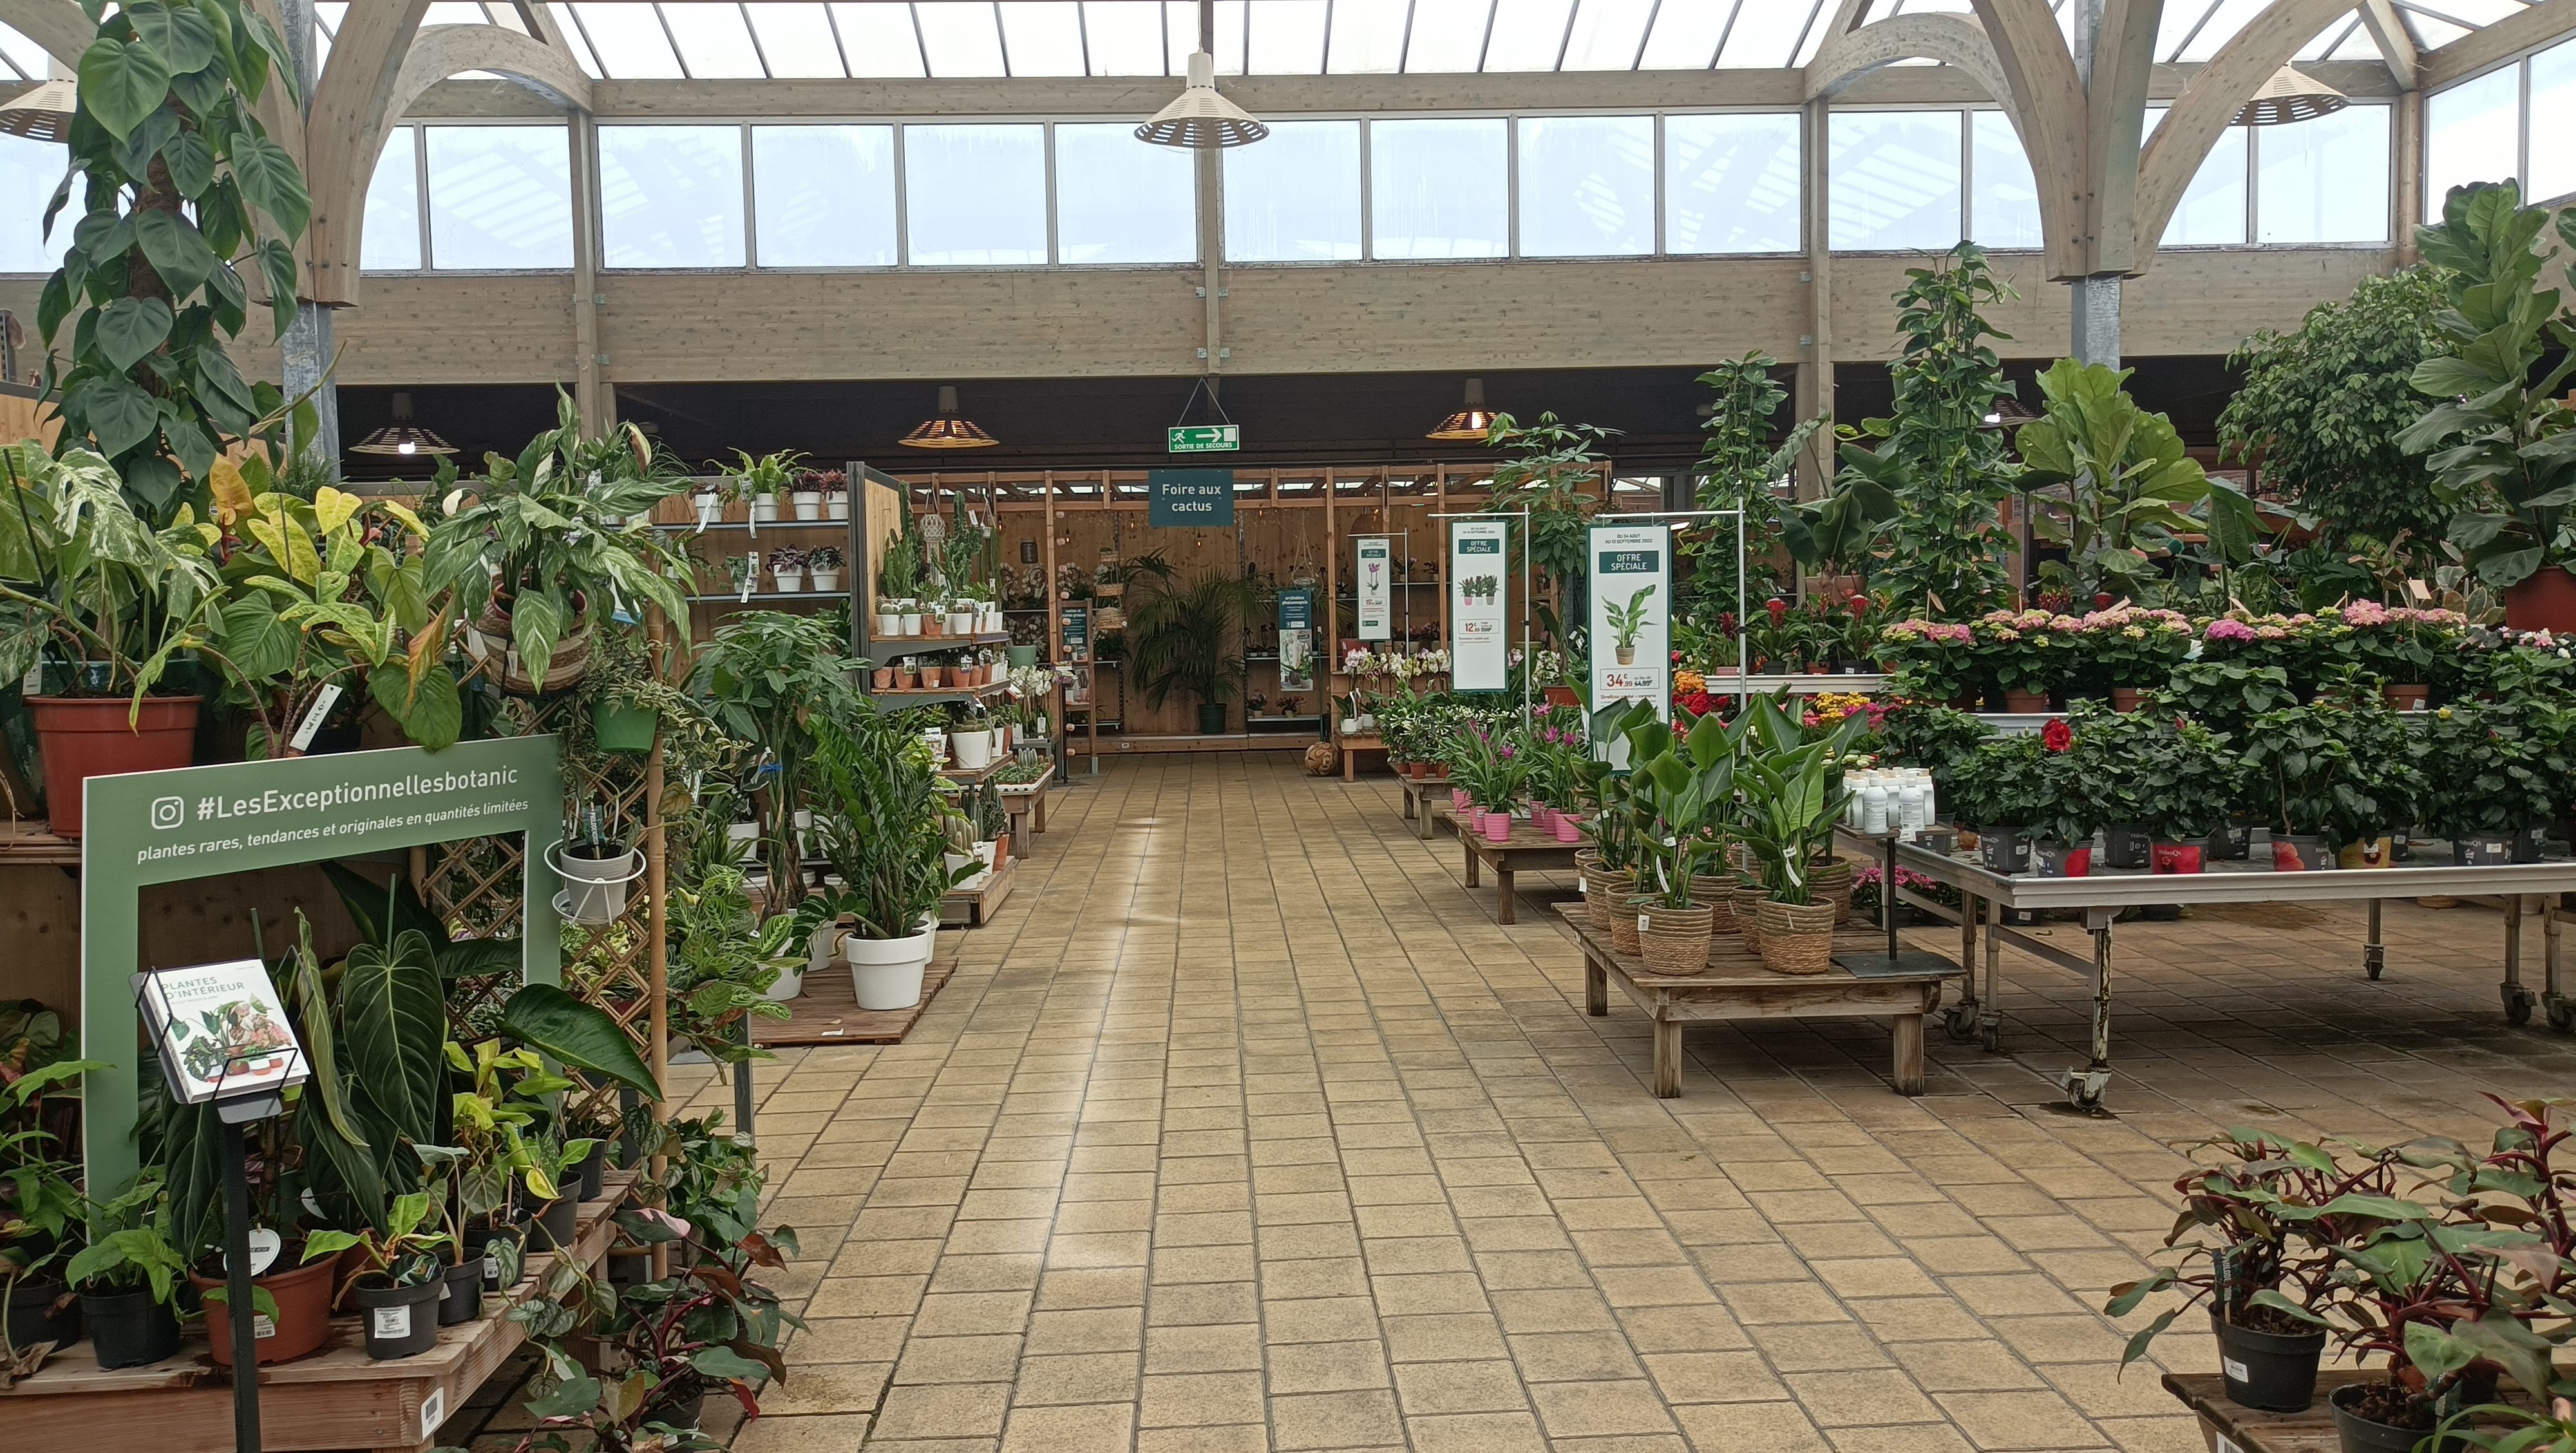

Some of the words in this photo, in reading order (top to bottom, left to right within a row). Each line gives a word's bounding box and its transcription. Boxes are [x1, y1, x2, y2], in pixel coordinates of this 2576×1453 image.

[1162, 484, 1195, 495] Foire
[1198, 485, 1221, 495] aux
[1171, 501, 1212, 511] cactus
[1611, 561, 1647, 570] SPÉCIALE
[197, 765, 518, 821] #LesExceptionnellesbotanic
[137, 846, 195, 864] plantes
[200, 838, 243, 853] rares,
[247, 827, 319, 846] tendances
[323, 823, 336, 836] et
[339, 815, 403, 835] originales
[406, 815, 421, 826] en
[425, 804, 480, 825] quantités
[483, 799, 529, 815] limitées
[162, 976, 218, 991] PLANTES
[166, 982, 245, 1000] D'INTÉRIEUR
